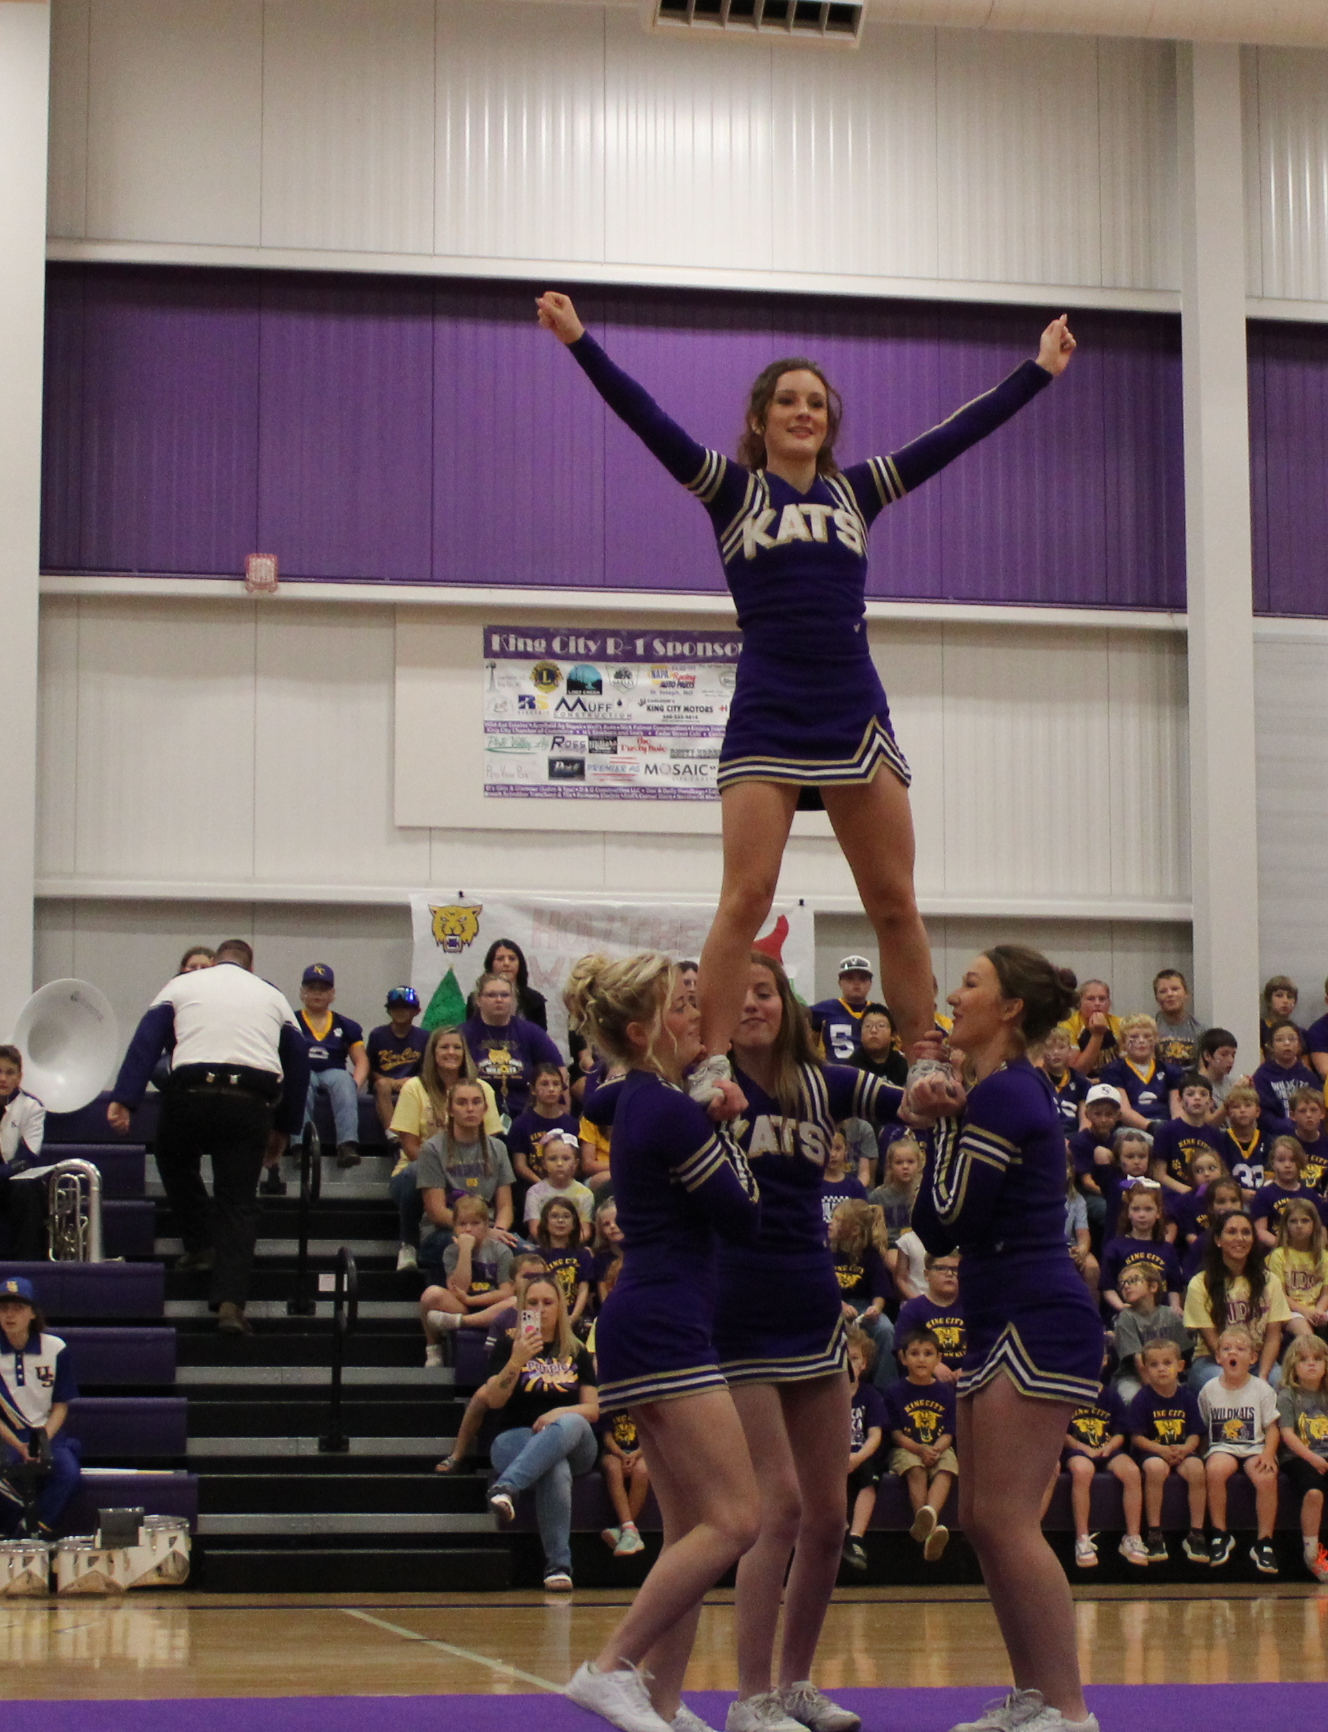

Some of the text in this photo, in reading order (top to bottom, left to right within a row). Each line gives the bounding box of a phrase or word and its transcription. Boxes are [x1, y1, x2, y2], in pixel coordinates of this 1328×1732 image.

[742, 503, 864, 560] KATS
[491, 633, 546, 653] King
[552, 636, 601, 656] City
[651, 668, 669, 679] NAPA
[555, 696, 612, 712] MUFF
[646, 704, 664, 712] KING
[683, 705, 713, 713] MOTORS
[644, 764, 708, 776] MOSAIC
[829, 1024, 855, 1059] 5
[1126, 1252, 1166, 1266] KING CITY
[926, 1317, 965, 1329] KING CITY
[904, 1399, 946, 1413] KING CITY
[1074, 1408, 1089, 1417] ING
[1153, 1410, 1168, 1418] ING
[1211, 1406, 1255, 1421] WILDKATS
